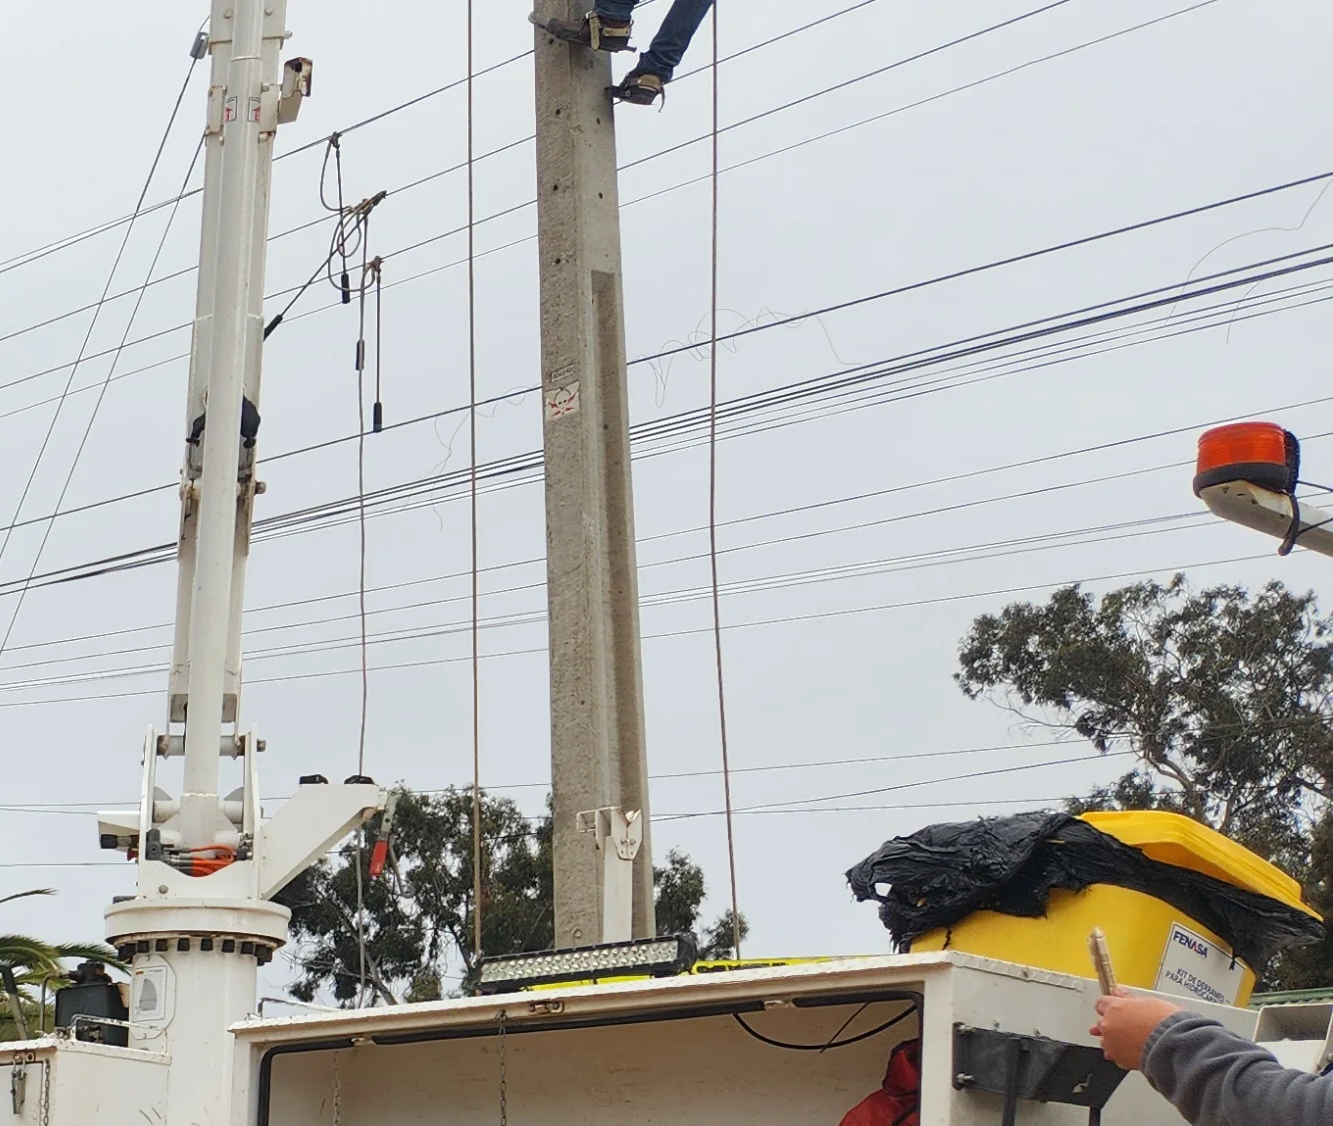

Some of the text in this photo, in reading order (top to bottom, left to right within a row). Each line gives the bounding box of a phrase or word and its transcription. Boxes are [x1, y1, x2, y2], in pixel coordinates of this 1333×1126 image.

[1173, 930, 1208, 958] FENASA
[1165, 970, 1183, 986] PARA
[1177, 968, 1188, 978] KIT
[1188, 974, 1197, 985] DE
